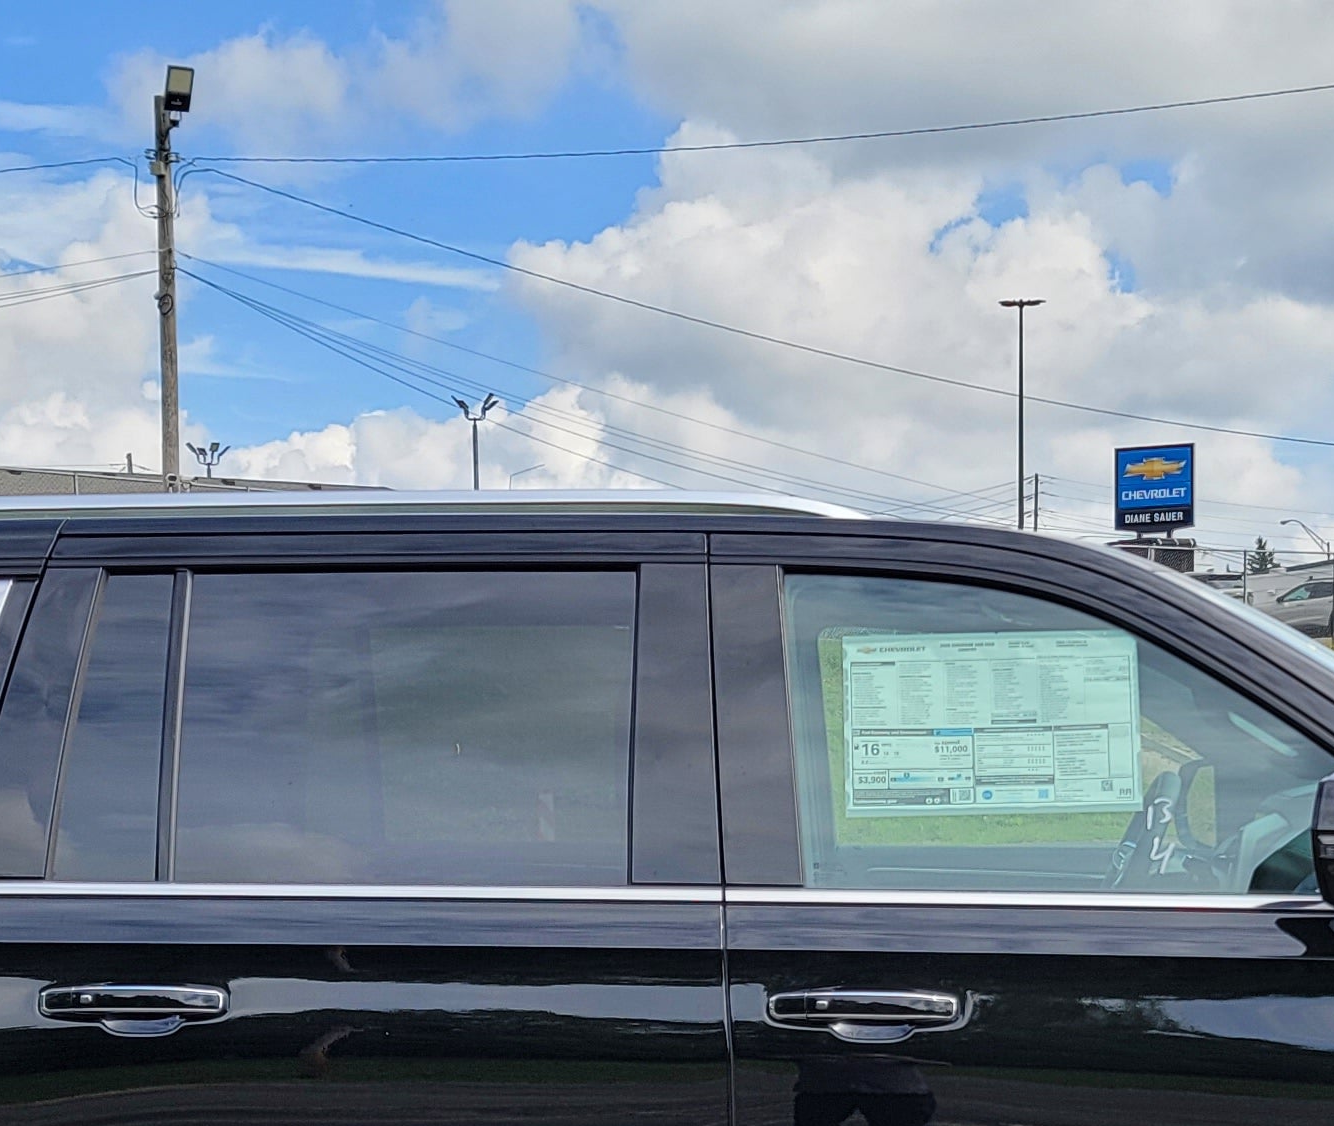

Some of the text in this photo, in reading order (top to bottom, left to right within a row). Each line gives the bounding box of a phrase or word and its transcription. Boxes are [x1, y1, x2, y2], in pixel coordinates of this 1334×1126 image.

[1121, 487, 1187, 501] CHEVROLET
[1124, 511, 1184, 524] DIANE SAUER
[879, 645, 926, 653] CHEVROLET
[861, 743, 880, 756] 16
